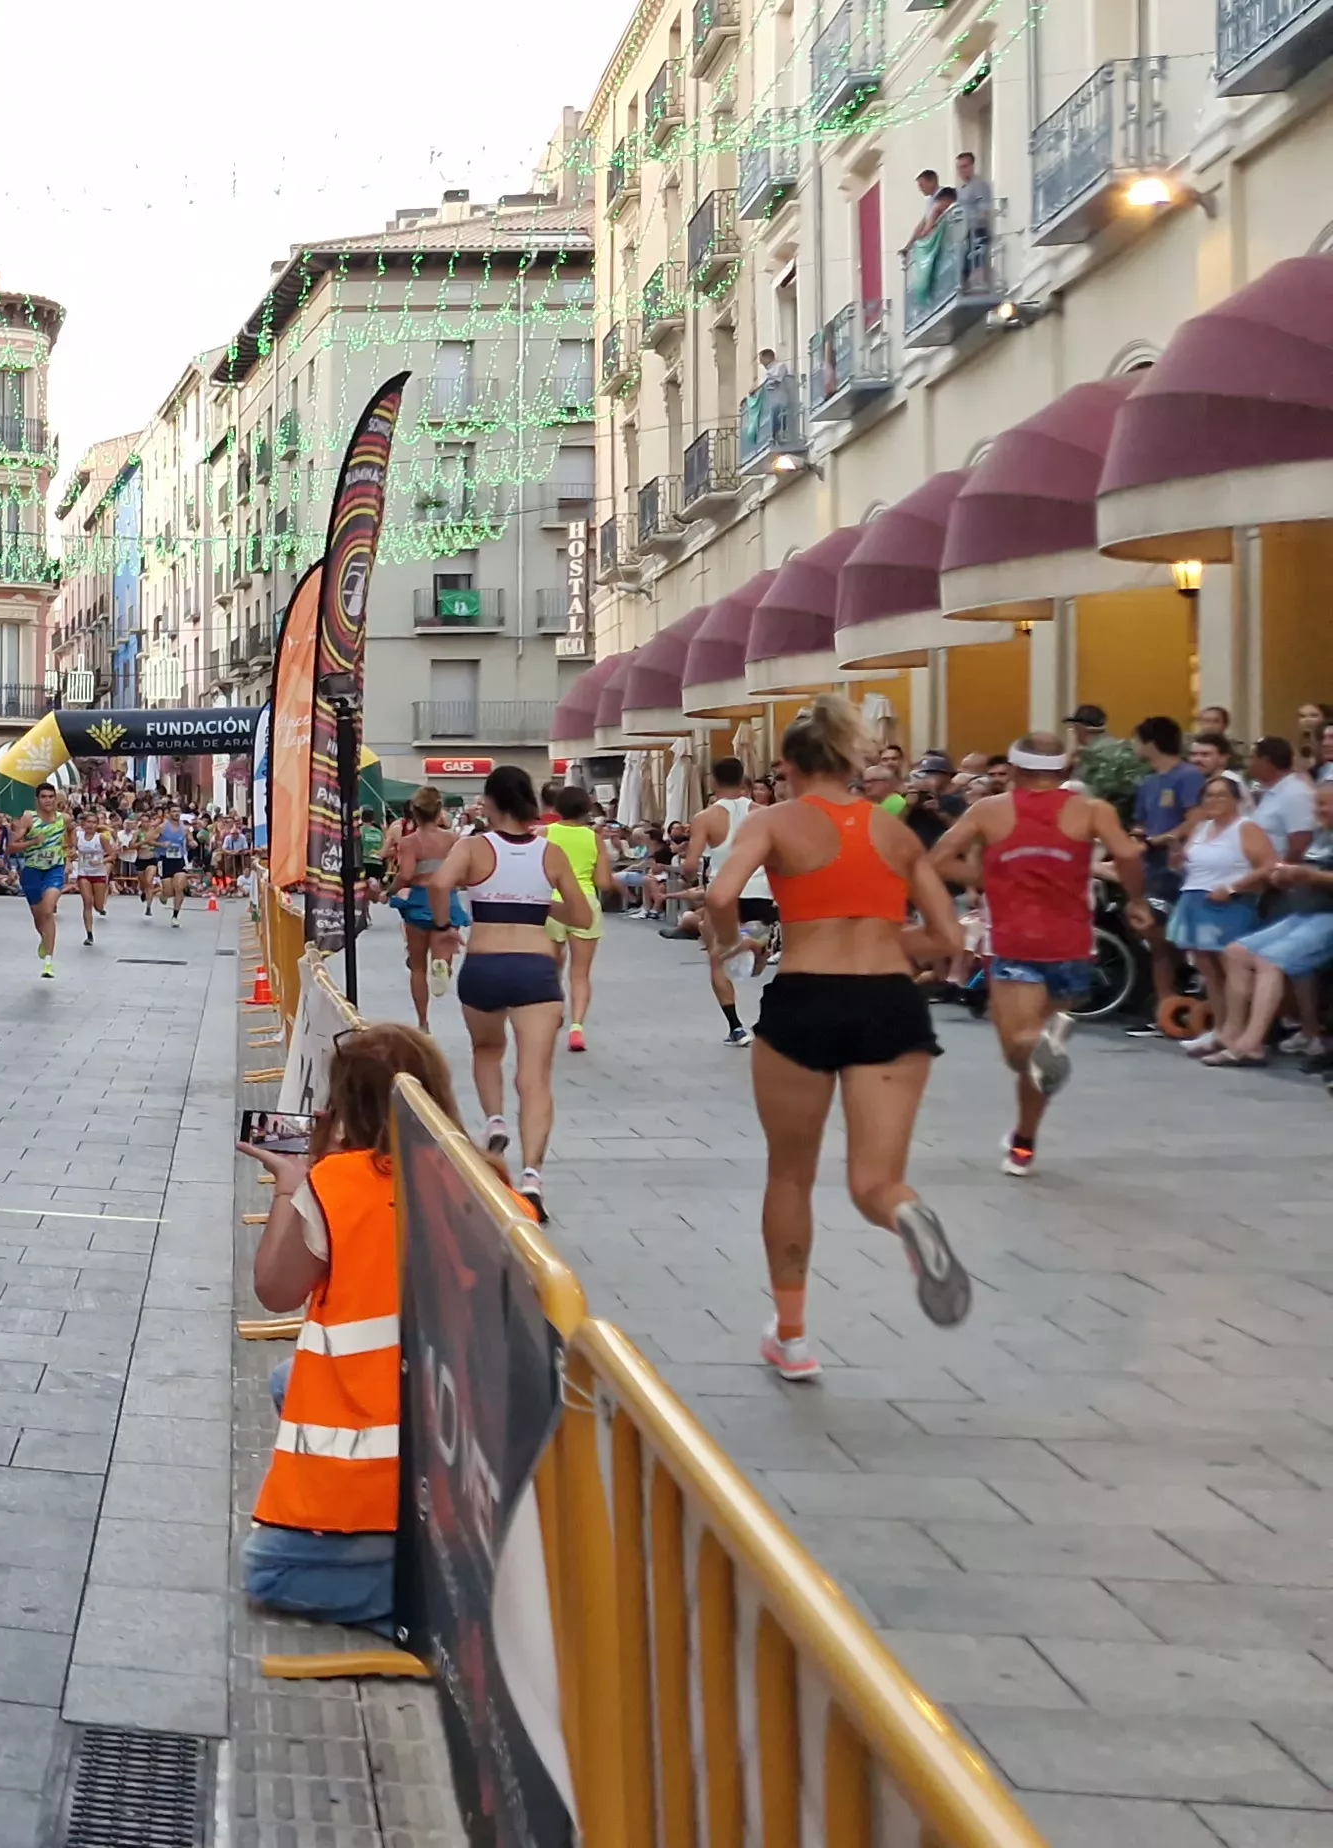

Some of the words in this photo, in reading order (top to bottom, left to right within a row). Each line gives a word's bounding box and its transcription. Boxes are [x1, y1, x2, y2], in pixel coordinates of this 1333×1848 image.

[568, 521, 586, 634] HOSTAL
[146, 716, 251, 736] FUNDACIÓN
[119, 741, 152, 750] CAJA
[157, 740, 197, 749] RURAL
[203, 739, 219, 748] DE
[442, 761, 474, 771] GAES
